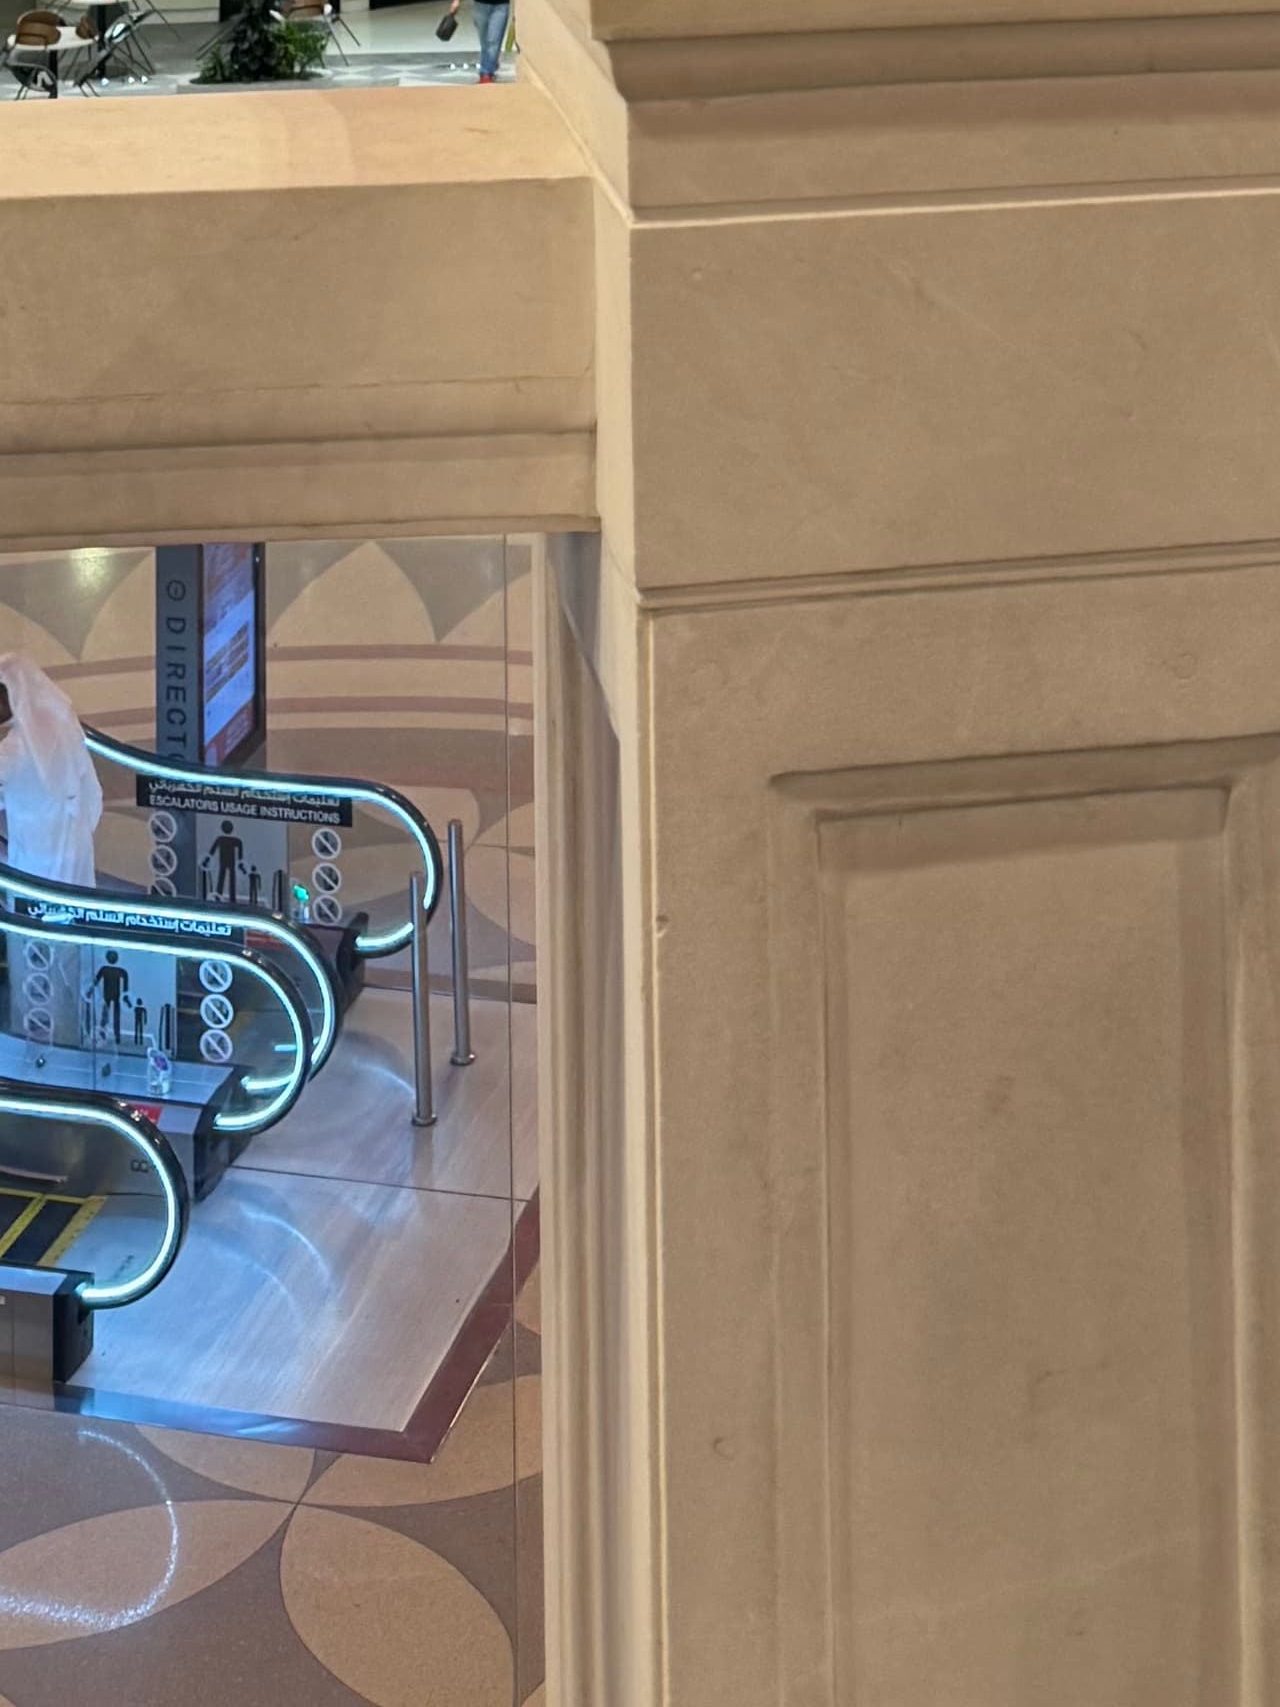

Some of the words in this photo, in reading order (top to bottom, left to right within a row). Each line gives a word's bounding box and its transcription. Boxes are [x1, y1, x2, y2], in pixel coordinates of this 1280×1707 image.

[149, 794, 220, 813] ESCALATORS
[220, 802, 258, 817] USAGE
[260, 806, 341, 825] INSTRUCTIONS
